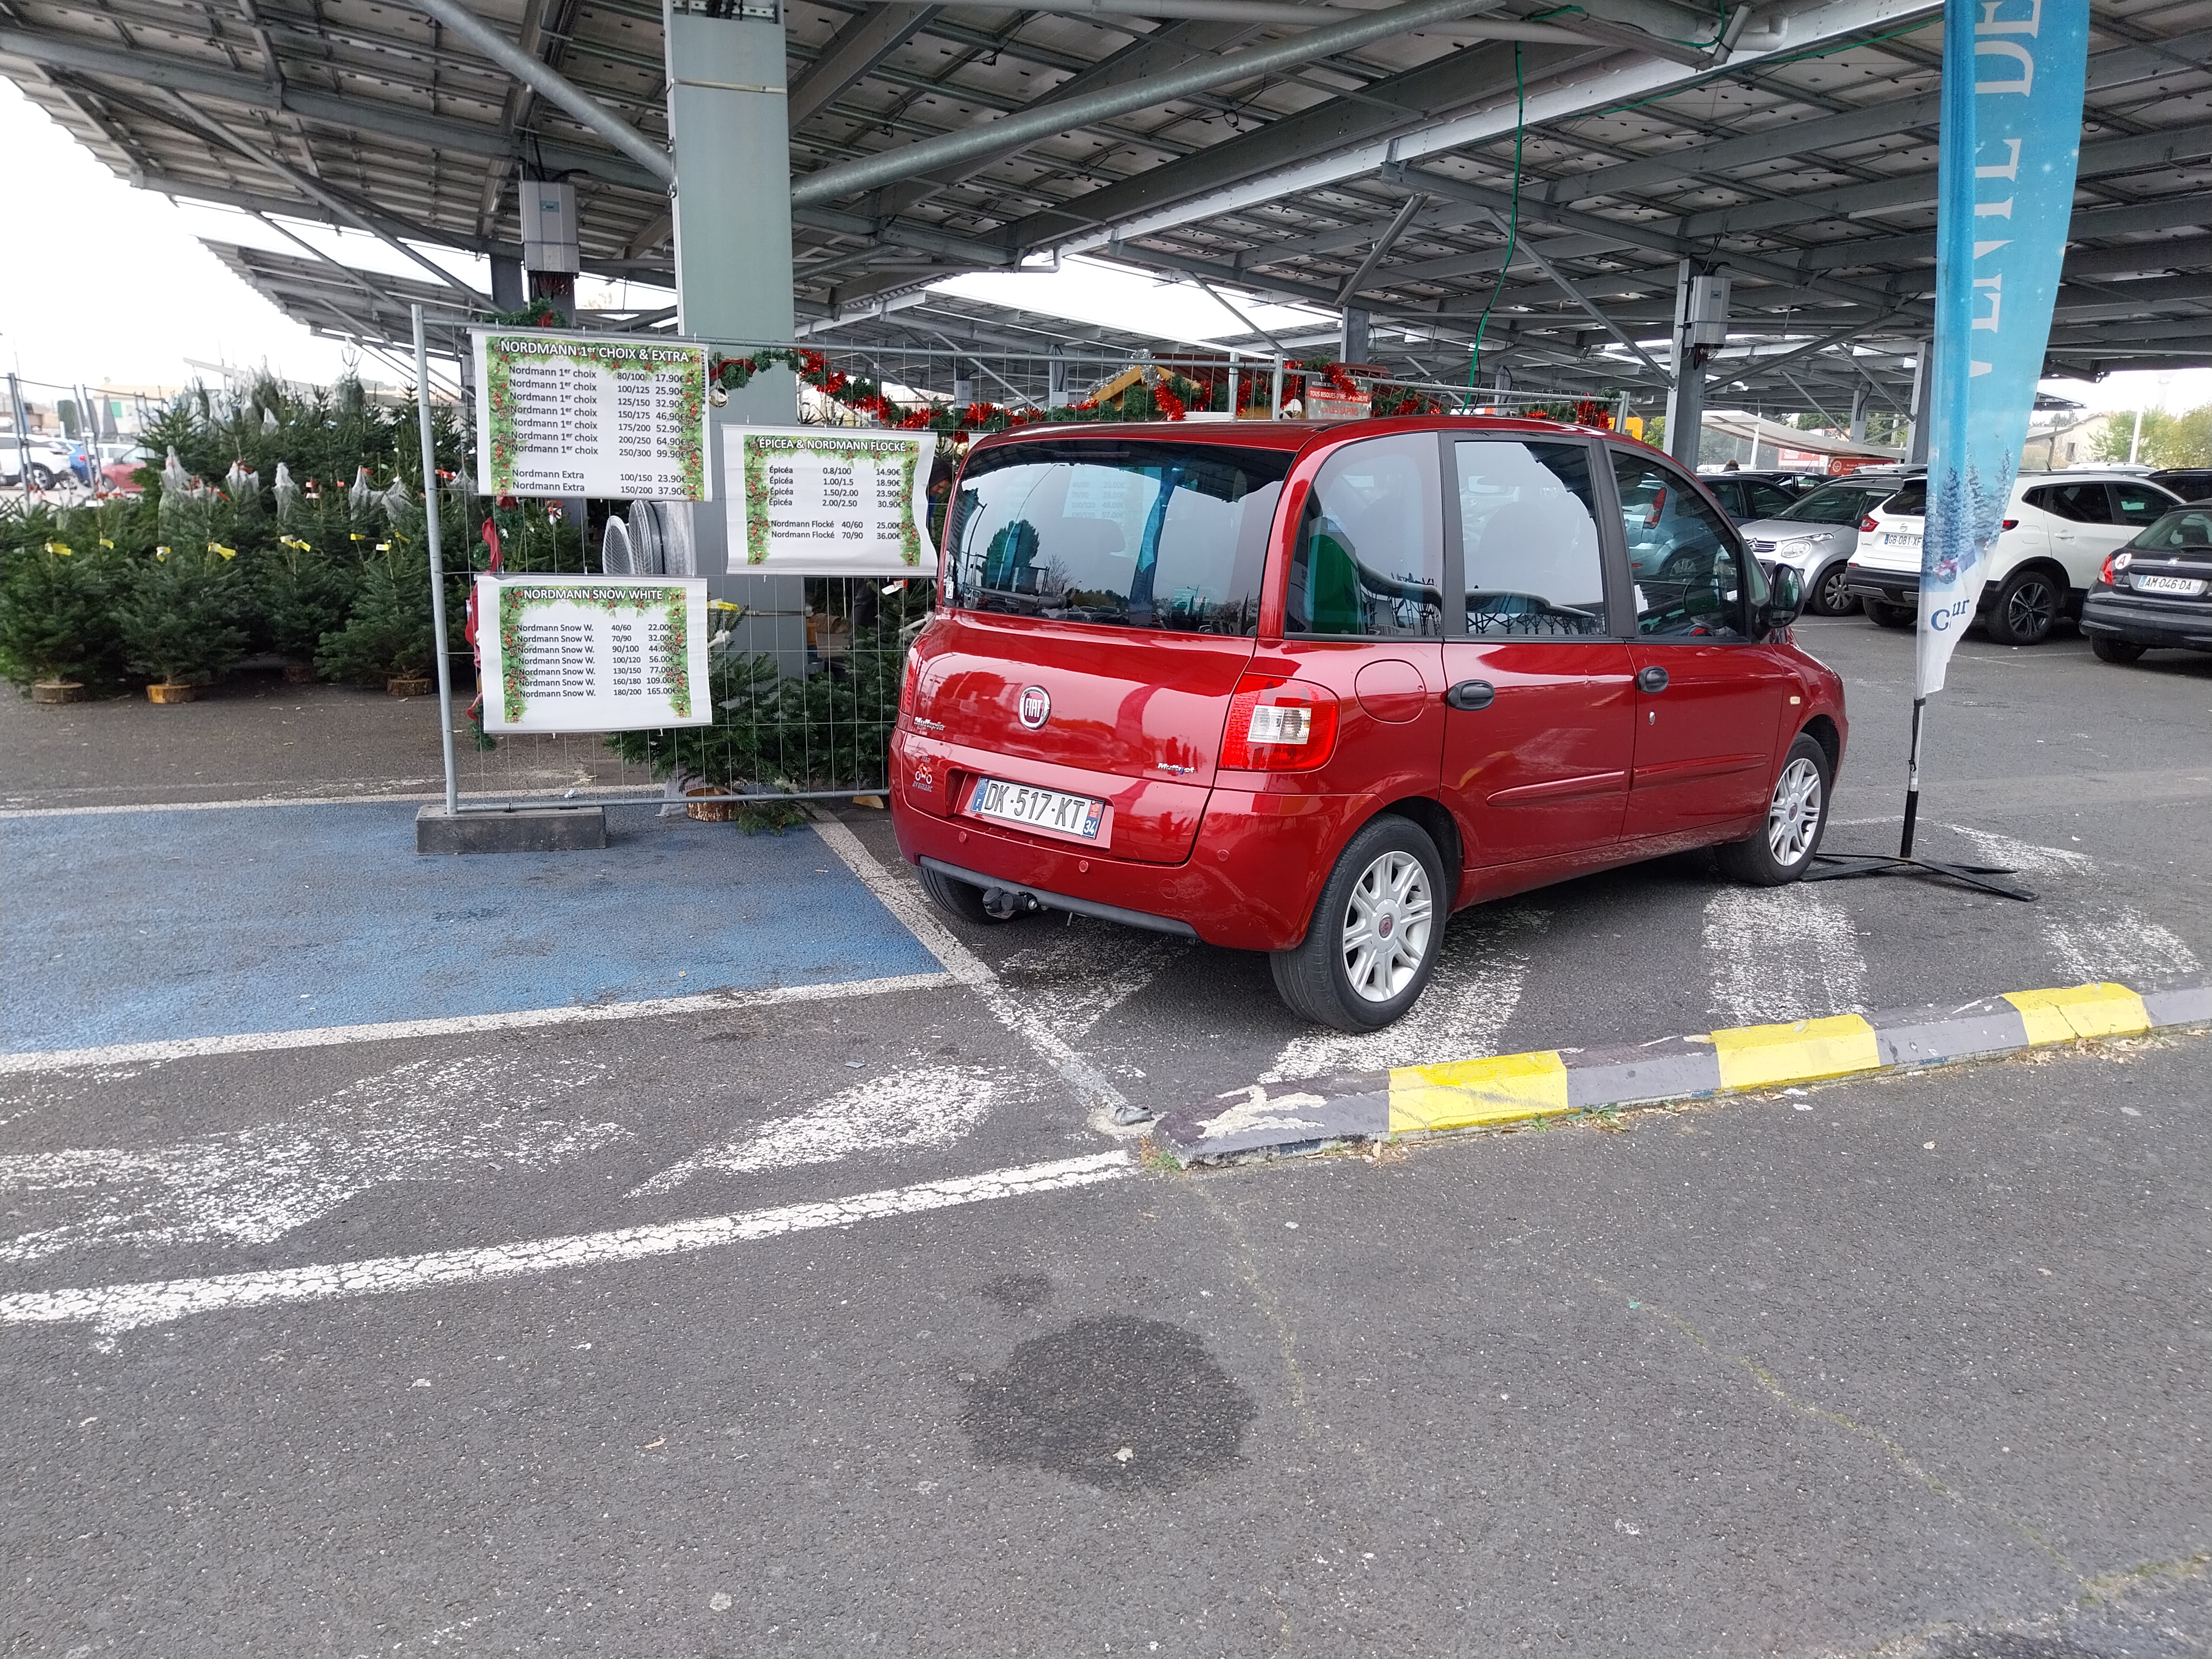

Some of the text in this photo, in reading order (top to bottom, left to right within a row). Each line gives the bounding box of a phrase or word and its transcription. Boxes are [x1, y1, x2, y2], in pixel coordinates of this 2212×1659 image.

[501, 341, 688, 362] NORDMANN 1er CHOIX & EXTRA
[509, 365, 556, 376] Nordmann
[573, 369, 596, 378] choix
[618, 372, 645, 381] 80/100
[656, 374, 685, 383] 17.90€
[510, 379, 556, 389] Nordmann
[574, 382, 596, 391] choix
[618, 385, 650, 394] 100/125
[656, 387, 685, 395] 25.90€
[510, 392, 557, 402] Nordmann
[574, 395, 596, 403] choix
[619, 398, 650, 407] 125/150
[656, 399, 685, 408] 32.90€
[510, 405, 557, 415] Nordmann
[574, 408, 597, 416] choix
[619, 411, 650, 419] 150/175
[656, 411, 685, 420] 46.90€
[1329, 405, 1338, 414] LES
[1339, 407, 1358, 415] SAPINS
[511, 418, 558, 428] Nordmann
[575, 421, 597, 429] choix
[619, 423, 651, 432] 175/200
[657, 424, 685, 433] 52.90€
[511, 431, 558, 441] Nordmann
[575, 433, 597, 442] choix
[619, 436, 651, 445] 200/250
[657, 437, 686, 446] 64.90€
[760, 438, 905, 451] ÉPICEA & NORDMANN FLOCKÉ
[511, 444, 558, 454] Nordmann
[575, 446, 598, 454] choix
[620, 449, 651, 457] 250/300
[657, 449, 686, 458] 99.90€
[512, 470, 560, 478] Nordmann
[621, 474, 652, 482] 100/150
[658, 474, 686, 483] 23.90€
[769, 465, 793, 474] Épicéa
[823, 467, 851, 475] 0.8/100
[513, 481, 687, 495] Nordmann Extra 150/200 37.90€
[770, 477, 793, 485] Épicéa
[824, 478, 853, 486] 1.00/1.5
[770, 487, 793, 497] Épicéa
[824, 489, 858, 497] 1.50/2.00
[769, 498, 792, 506] Épicéa
[822, 499, 857, 507] 2.00/2.50
[843, 531, 863, 539] 70/90
[2117, 555, 2126, 566] A
[524, 589, 663, 600] NORDMANN SNOW WHITE
[613, 645, 639, 653] 90/100
[1025, 698, 1043, 718] FIAT
[976, 799, 981, 807] F
[1084, 820, 1097, 834] 34
